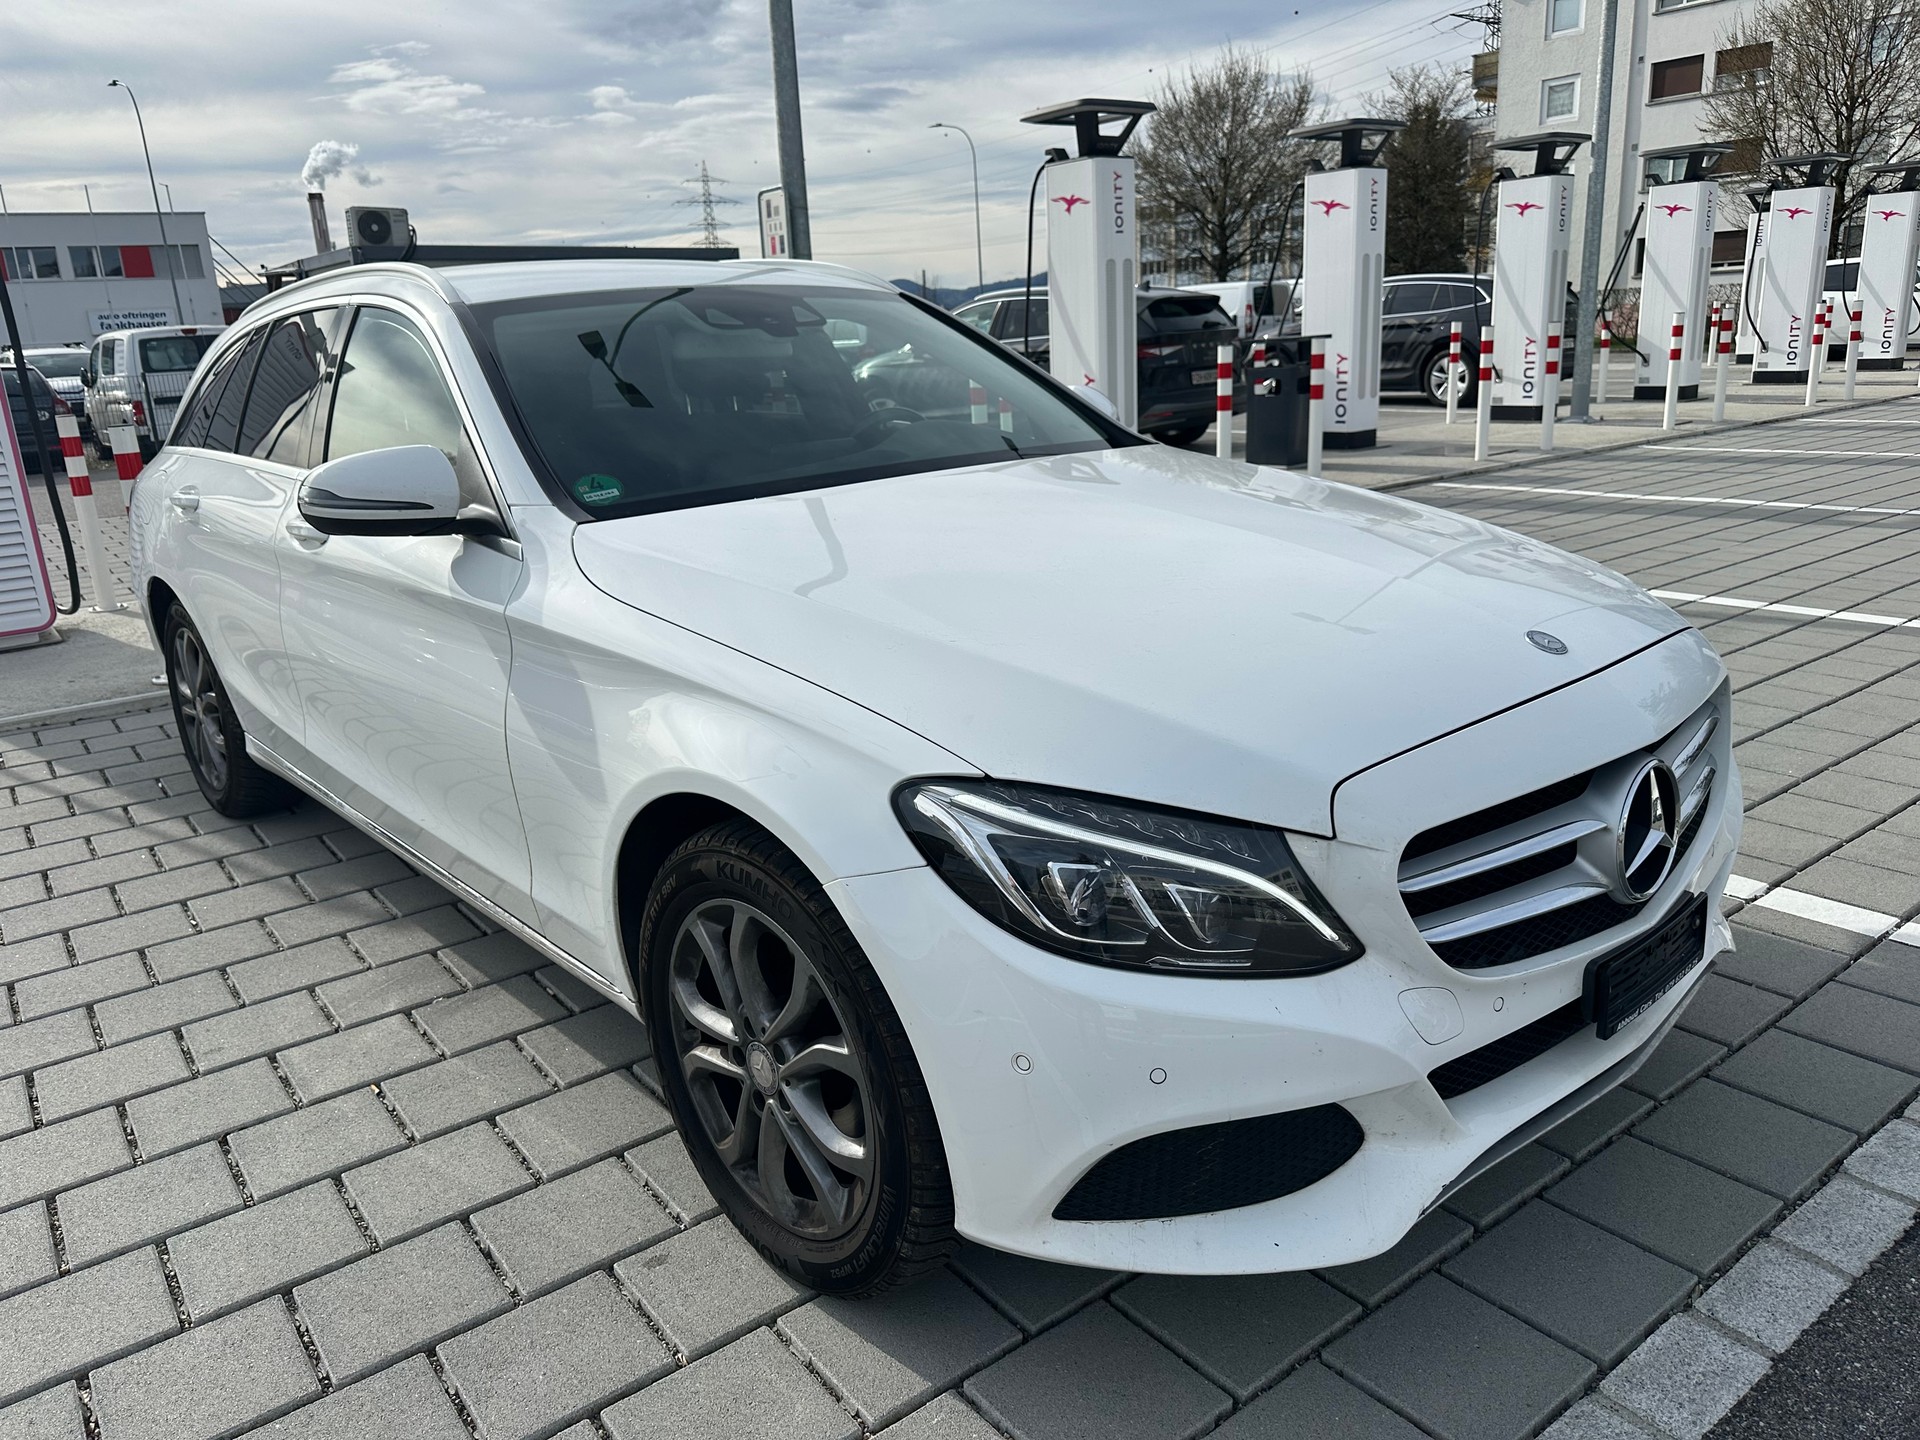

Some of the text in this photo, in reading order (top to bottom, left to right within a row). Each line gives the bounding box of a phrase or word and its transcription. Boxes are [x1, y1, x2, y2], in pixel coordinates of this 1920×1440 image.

[1113, 171, 1125, 234] IONITY
[1369, 178, 1378, 232] IONITY
[1559, 185, 1568, 232] IONITY
[1705, 190, 1713, 231] IONITY
[1823, 194, 1831, 232] IONITY
[122, 312, 167, 321] oftringen
[1786, 314, 1802, 365] IONITY
[1880, 307, 1896, 353] IONITY
[1335, 353, 1348, 424] IONITY
[1522, 336, 1536, 399] IONITY
[650, 894, 662, 922] R17
[661, 874, 677, 899] 98V
[716, 860, 793, 921] KUMHO
